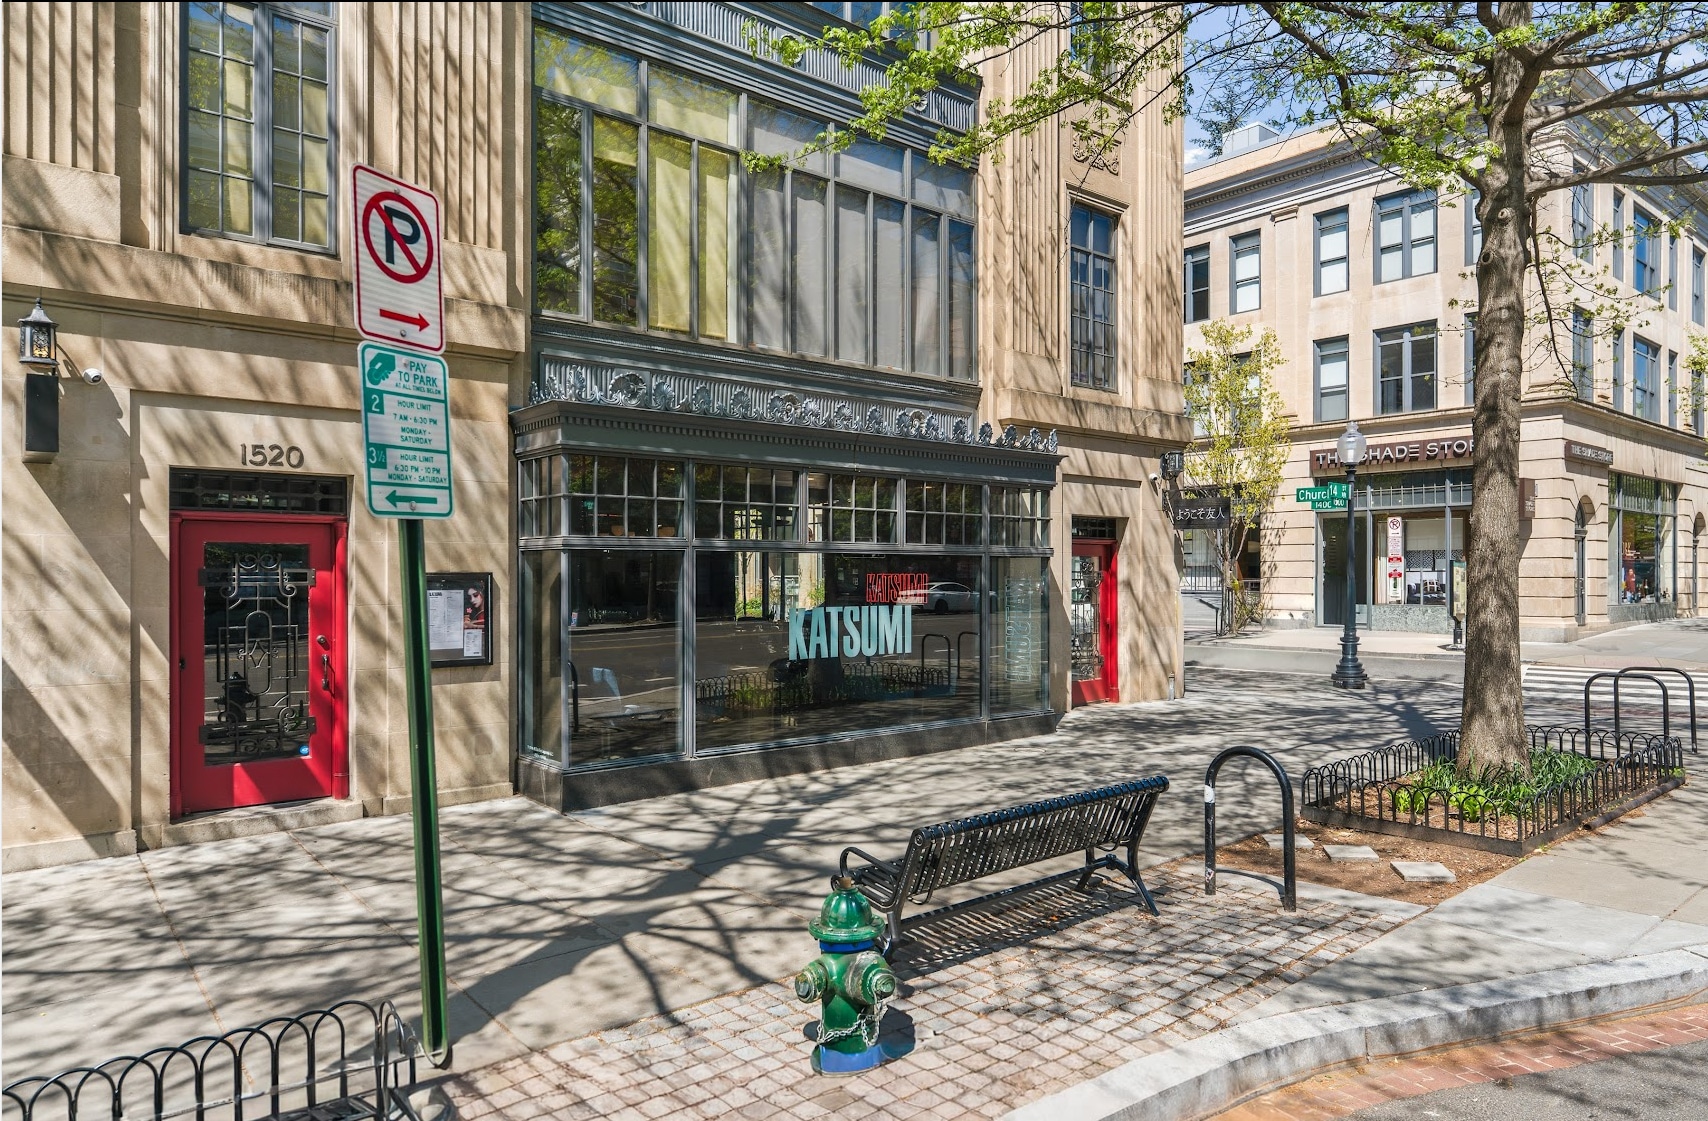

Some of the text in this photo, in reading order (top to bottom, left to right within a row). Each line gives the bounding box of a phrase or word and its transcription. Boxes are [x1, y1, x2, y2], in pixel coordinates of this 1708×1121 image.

[409, 360, 427, 374] PAY
[398, 370, 438, 388] TO PARK
[412, 385, 426, 393] TIMES
[426, 387, 441, 395] BELOW
[371, 394, 380, 412] 2
[397, 400, 432, 411] HOUR LIMIT
[429, 418, 438, 426] PM
[401, 426, 427, 436] MONDAY
[400, 436, 432, 444] SATURDAY
[240, 443, 304, 469] 1520
[1316, 452, 1343, 465] TH
[1330, 484, 1338, 496] 14
[1176, 507, 1225, 520] ようこそ友人
[866, 573, 928, 604] KATSUMI
[789, 605, 912, 661] KATSUMI
